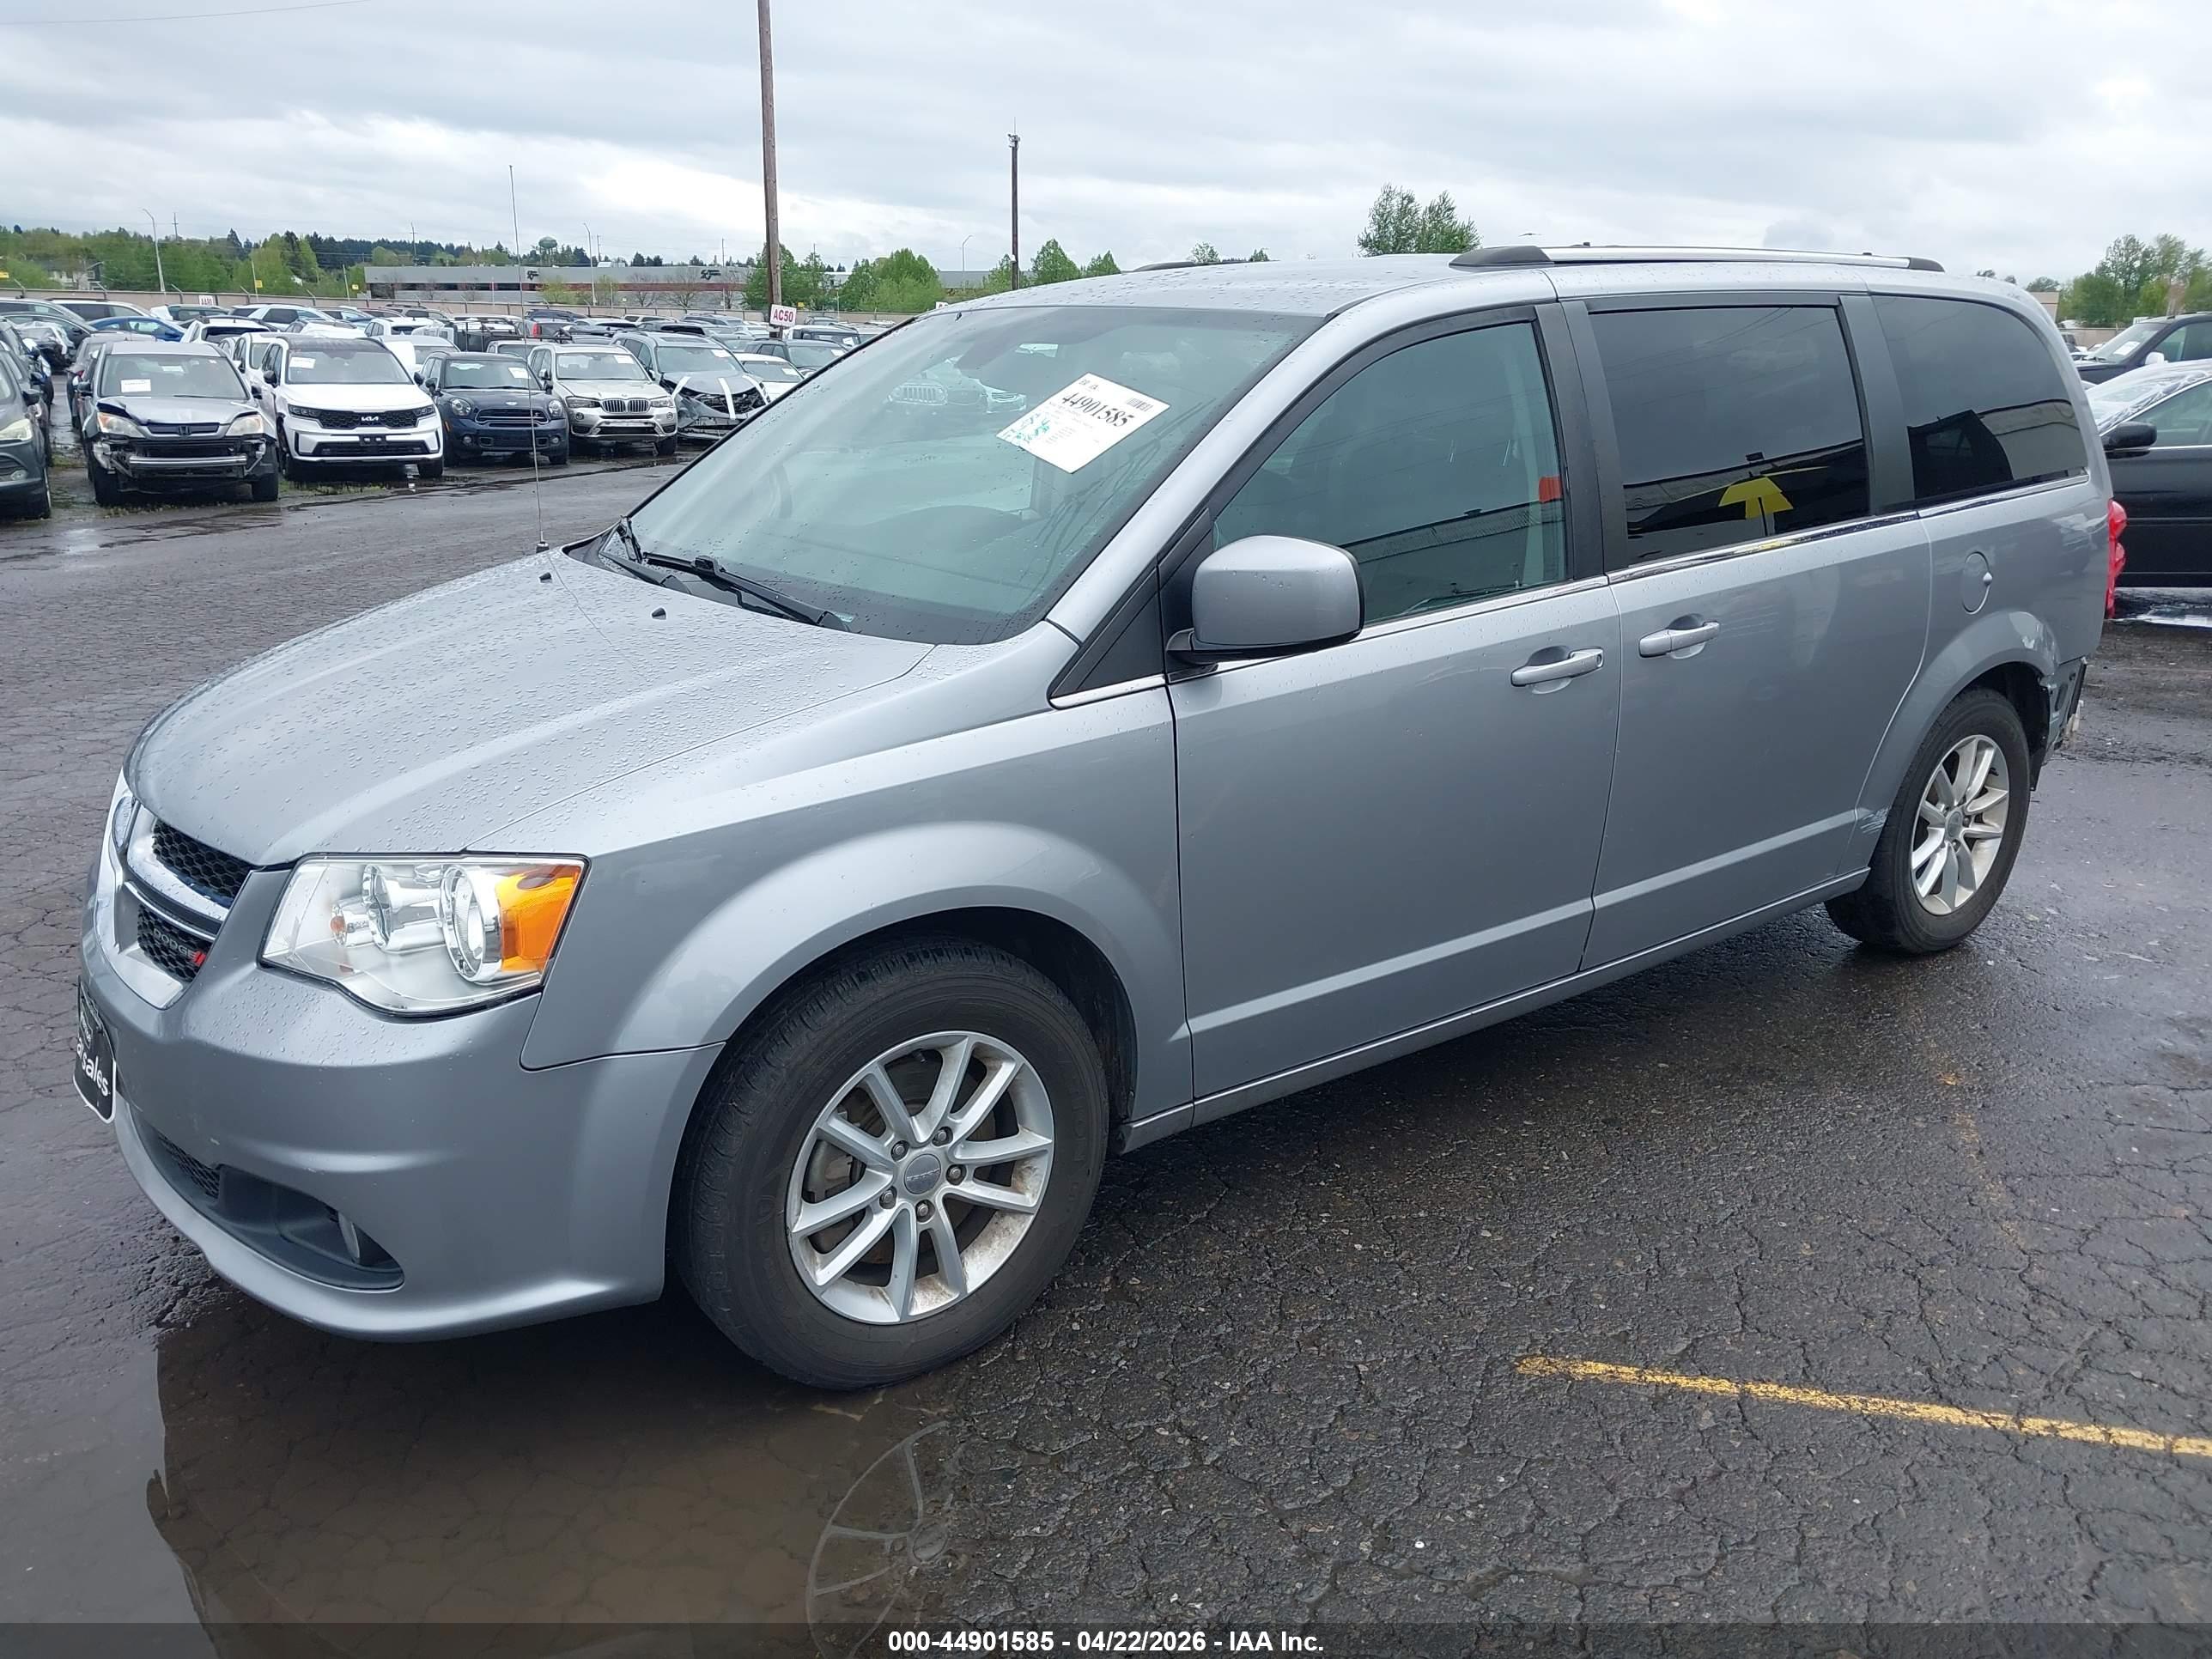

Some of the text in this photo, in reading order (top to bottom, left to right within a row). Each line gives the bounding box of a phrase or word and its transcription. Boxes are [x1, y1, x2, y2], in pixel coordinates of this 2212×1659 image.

[773, 308, 793, 323] AC50
[1061, 392, 1135, 428] 44901585
[153, 927, 197, 959] DODGE
